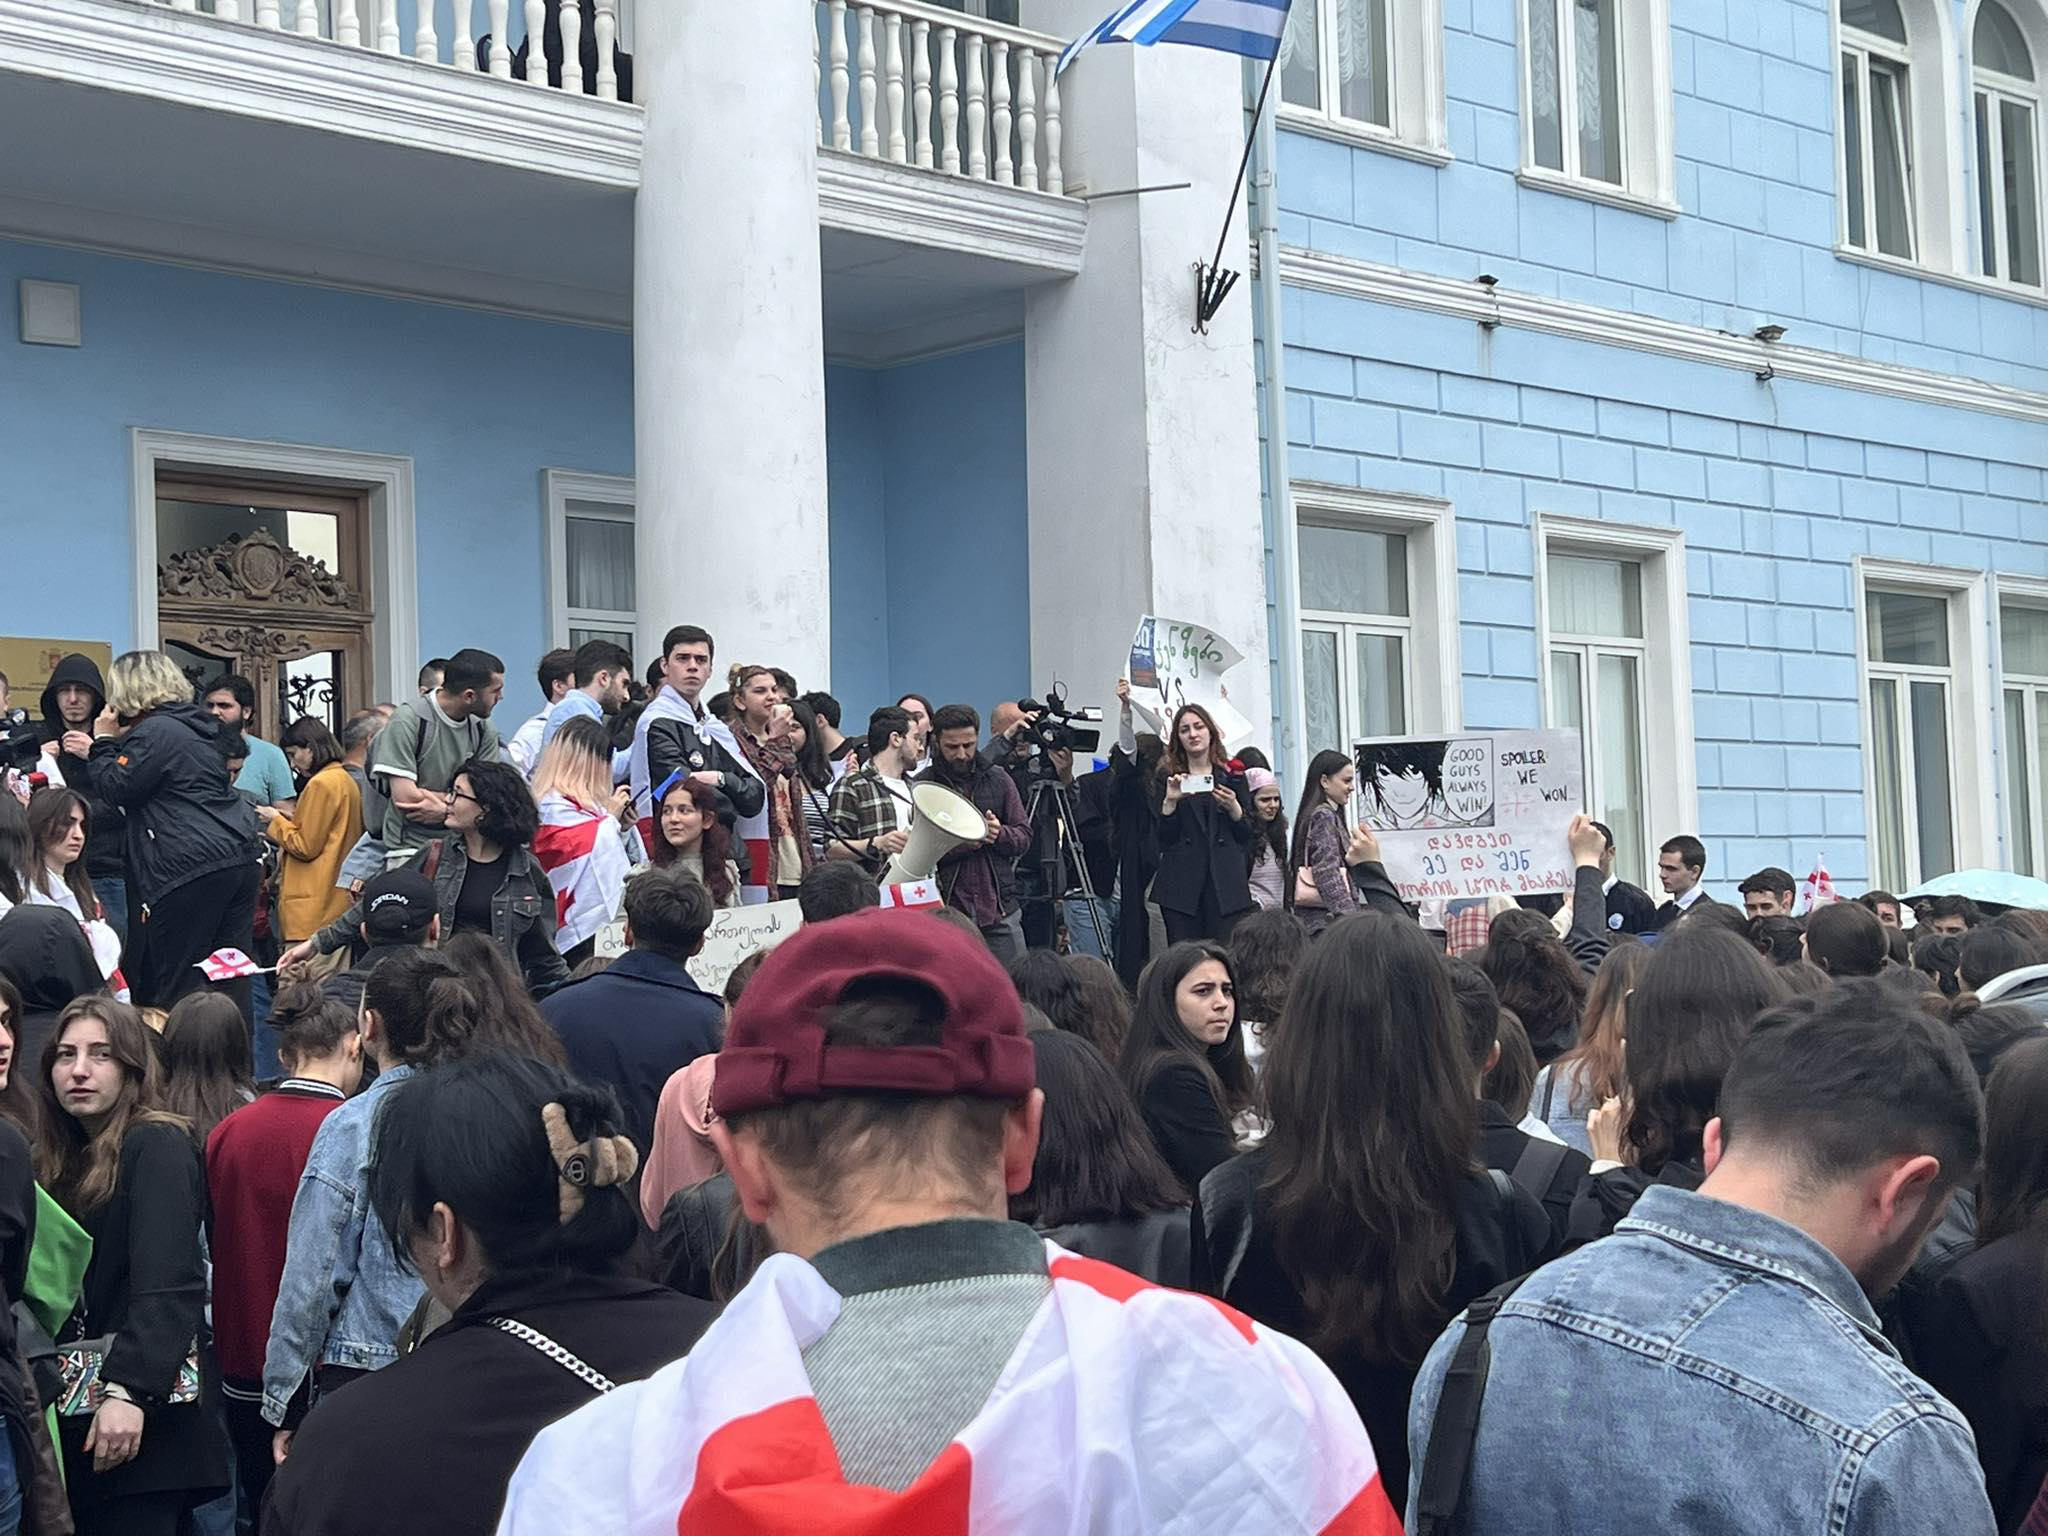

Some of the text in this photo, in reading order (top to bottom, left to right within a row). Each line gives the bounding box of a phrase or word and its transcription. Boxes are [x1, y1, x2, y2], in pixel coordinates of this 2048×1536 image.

[1450, 747, 1485, 763] GOOD
[1449, 763, 1481, 778] GUYS
[1447, 779, 1487, 793] ALWAYS
[1456, 795, 1488, 813] WIN!
[1422, 849, 1532, 876] მე და შენ
[370, 893, 409, 912] JORDAN
